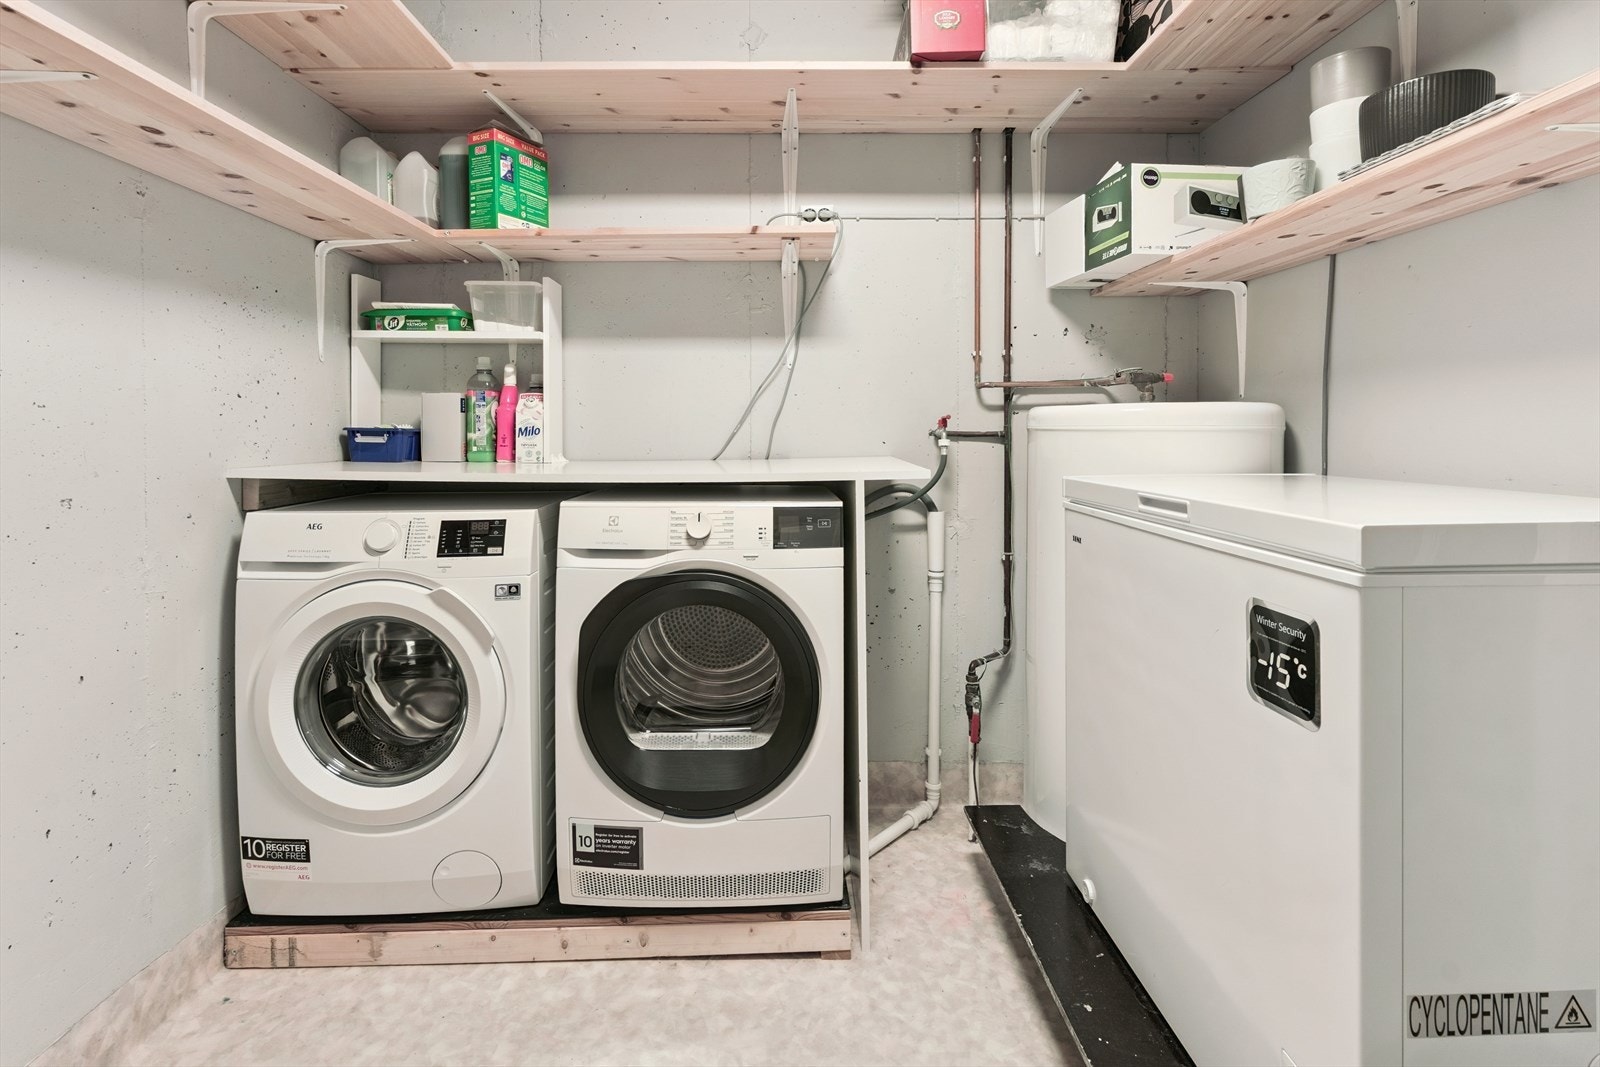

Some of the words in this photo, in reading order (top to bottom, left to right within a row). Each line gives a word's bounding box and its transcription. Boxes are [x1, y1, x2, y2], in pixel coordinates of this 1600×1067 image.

[480, 132, 490, 140] SIZE
[521, 144, 534, 154] VALUE
[534, 148, 546, 158] PACK
[517, 425, 541, 438] Milo
[1256, 613, 1277, 630] Winter
[1278, 622, 1307, 642] Security
[265, 843, 307, 852] REGISTER
[578, 835, 593, 848] 10
[611, 838, 637, 846] warranty
[243, 838, 266, 859] 10
[266, 851, 284, 859] FOR
[285, 852, 307, 860] FREE
[1408, 991, 1550, 1038] CYCLOPENTANE
